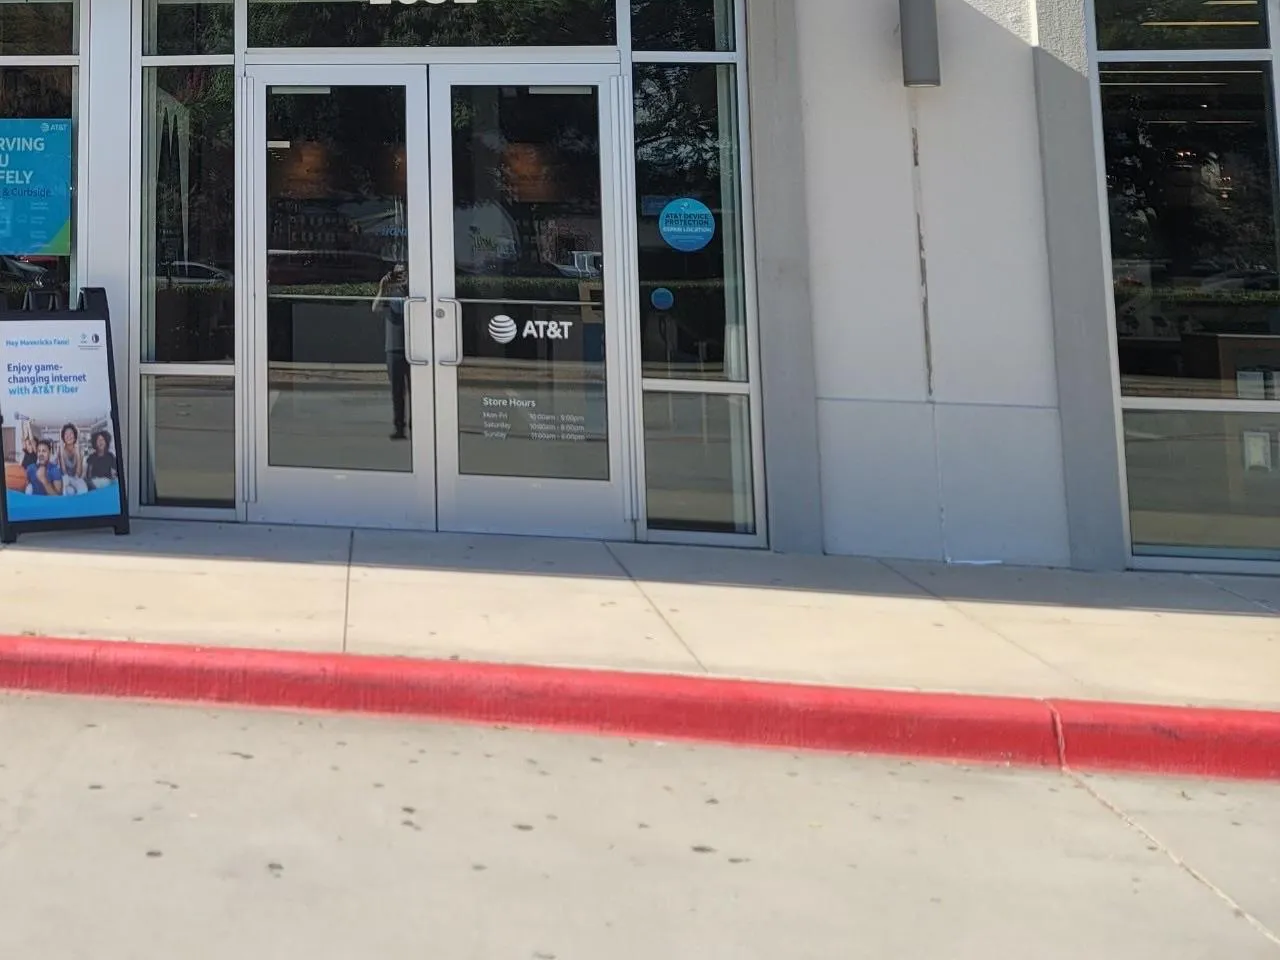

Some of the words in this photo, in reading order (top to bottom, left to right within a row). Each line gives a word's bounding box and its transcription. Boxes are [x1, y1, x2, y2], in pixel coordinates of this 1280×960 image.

[51, 123, 68, 131] AT&T
[2, 187, 10, 197] &
[522, 320, 573, 340] AT&T
[6, 339, 18, 347] Hey
[7, 363, 34, 374] Enjoy
[34, 363, 63, 374] game-
[8, 374, 50, 385] changing
[51, 373, 87, 383] internet
[8, 385, 30, 396] with
[31, 385, 55, 394] AT&T
[56, 384, 79, 394] Fiber
[482, 396, 508, 407] Store
[509, 398, 537, 408] Hours
